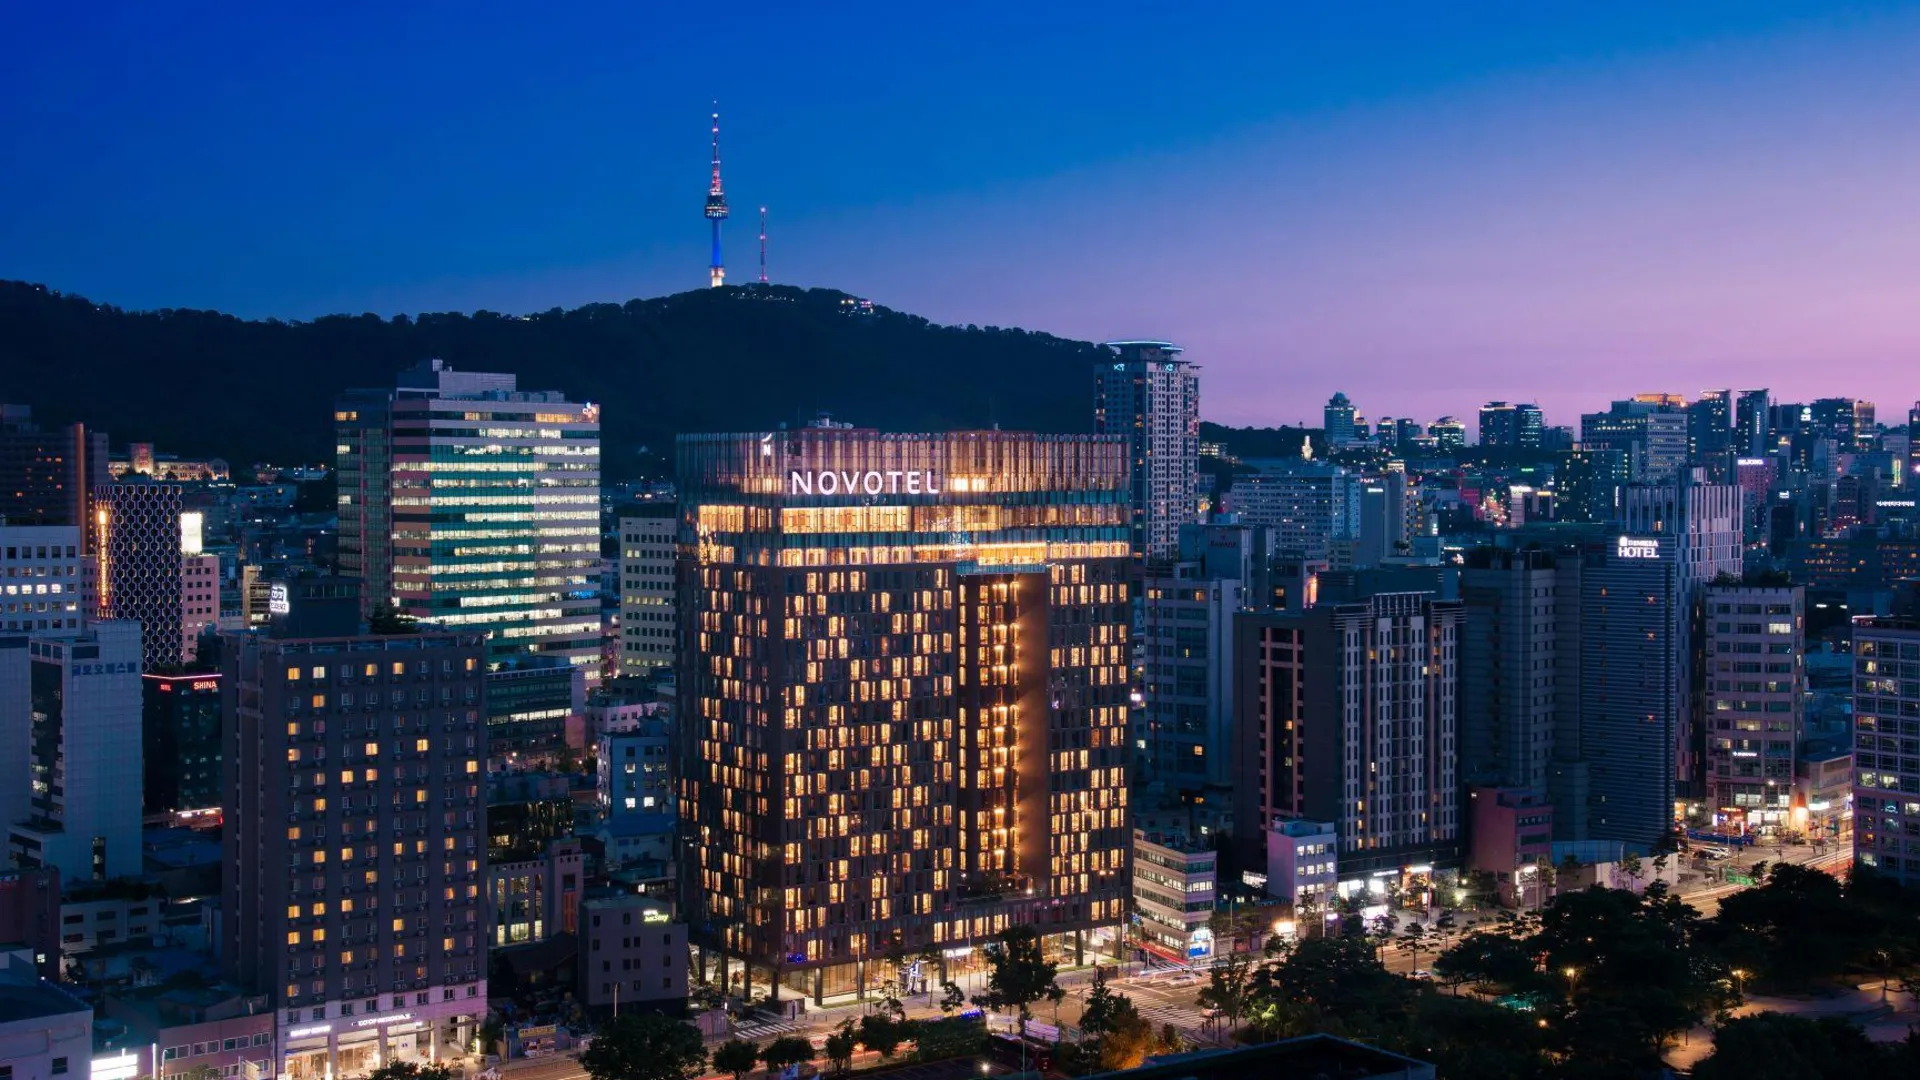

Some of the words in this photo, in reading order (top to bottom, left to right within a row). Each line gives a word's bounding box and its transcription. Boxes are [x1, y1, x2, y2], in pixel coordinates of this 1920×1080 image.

[792, 471, 940, 496] NOVOTEL
[1618, 546, 1660, 558] HOTEL
[193, 680, 217, 690] SHINA
